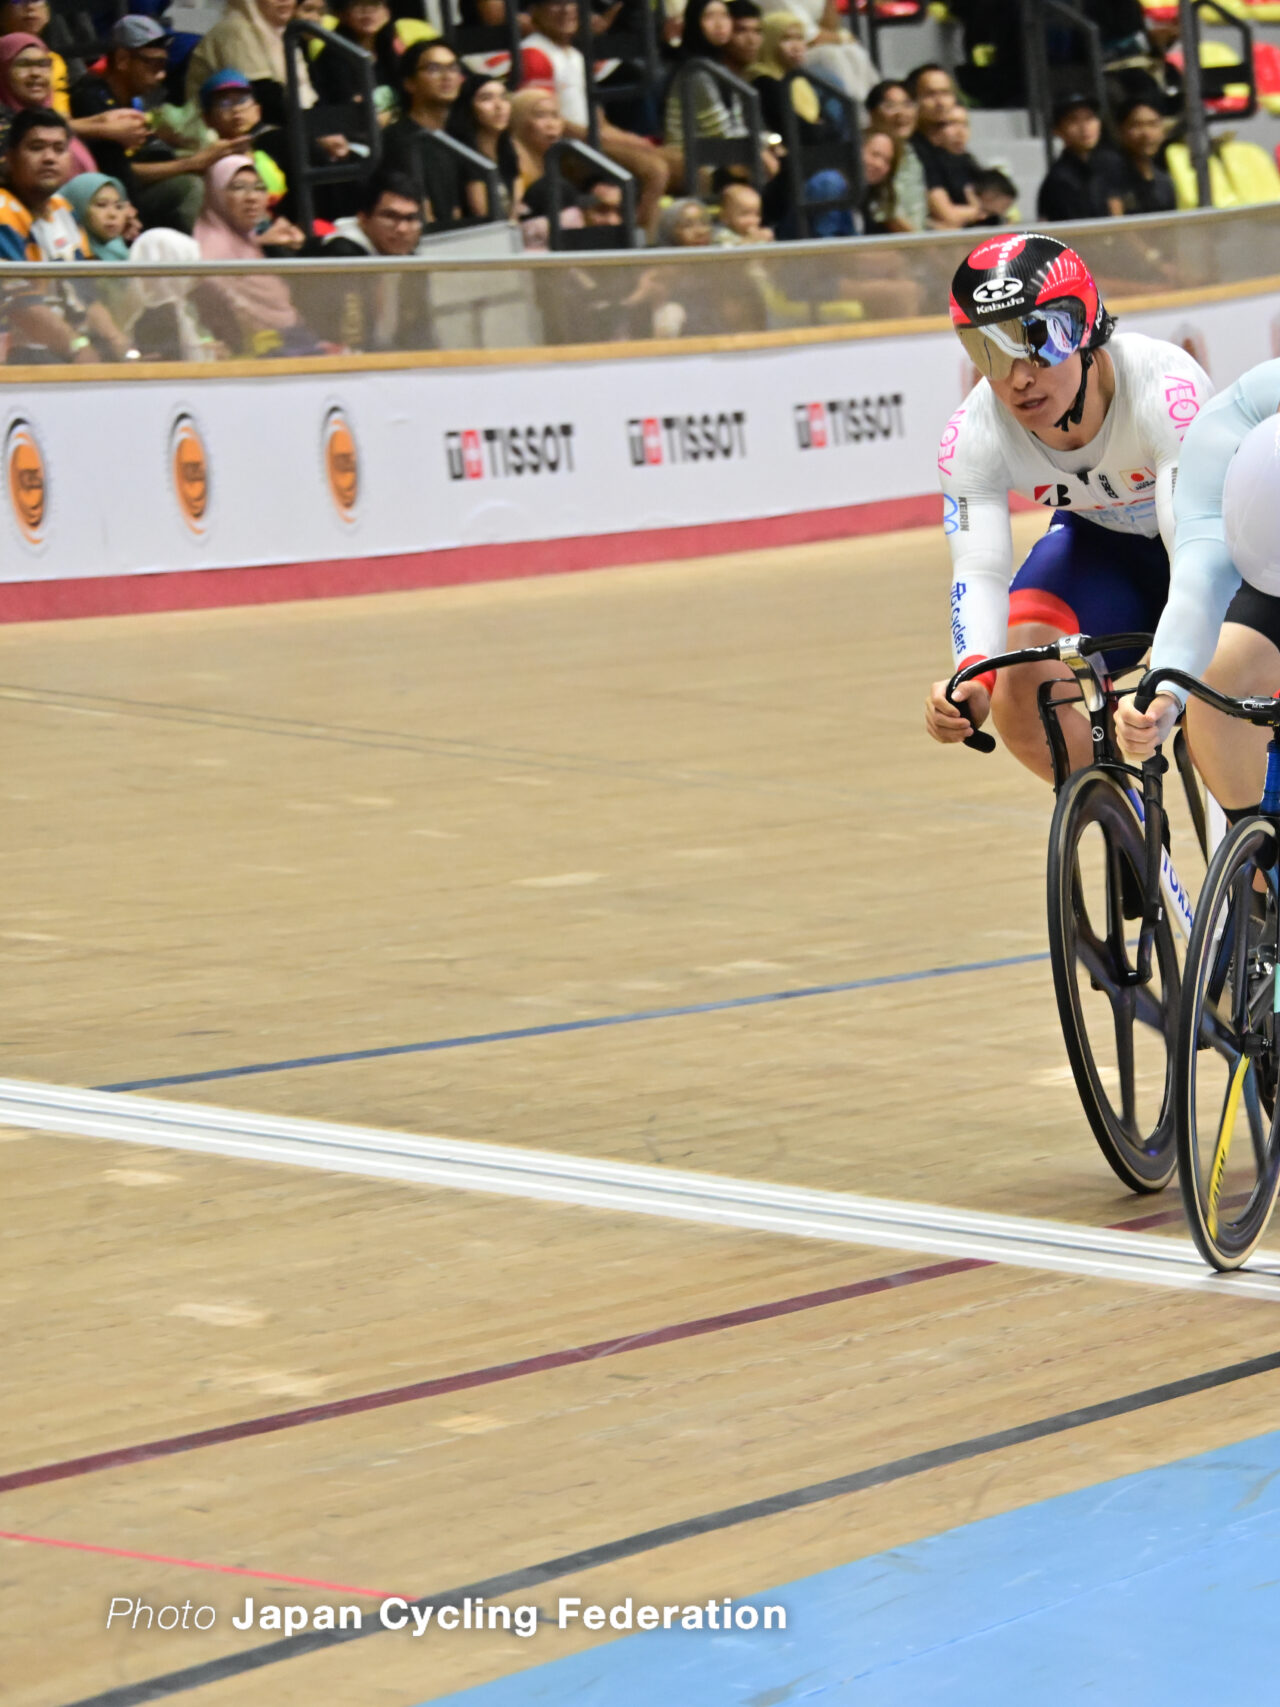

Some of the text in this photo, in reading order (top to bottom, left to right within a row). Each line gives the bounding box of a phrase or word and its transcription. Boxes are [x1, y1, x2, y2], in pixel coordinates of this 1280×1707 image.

[976, 297, 1025, 314] Kabuto
[662, 411, 746, 464] TISSOT
[826, 393, 904, 445] TISSOT
[484, 424, 574, 477] TISSOT
[958, 496, 970, 531] KEIRIN
